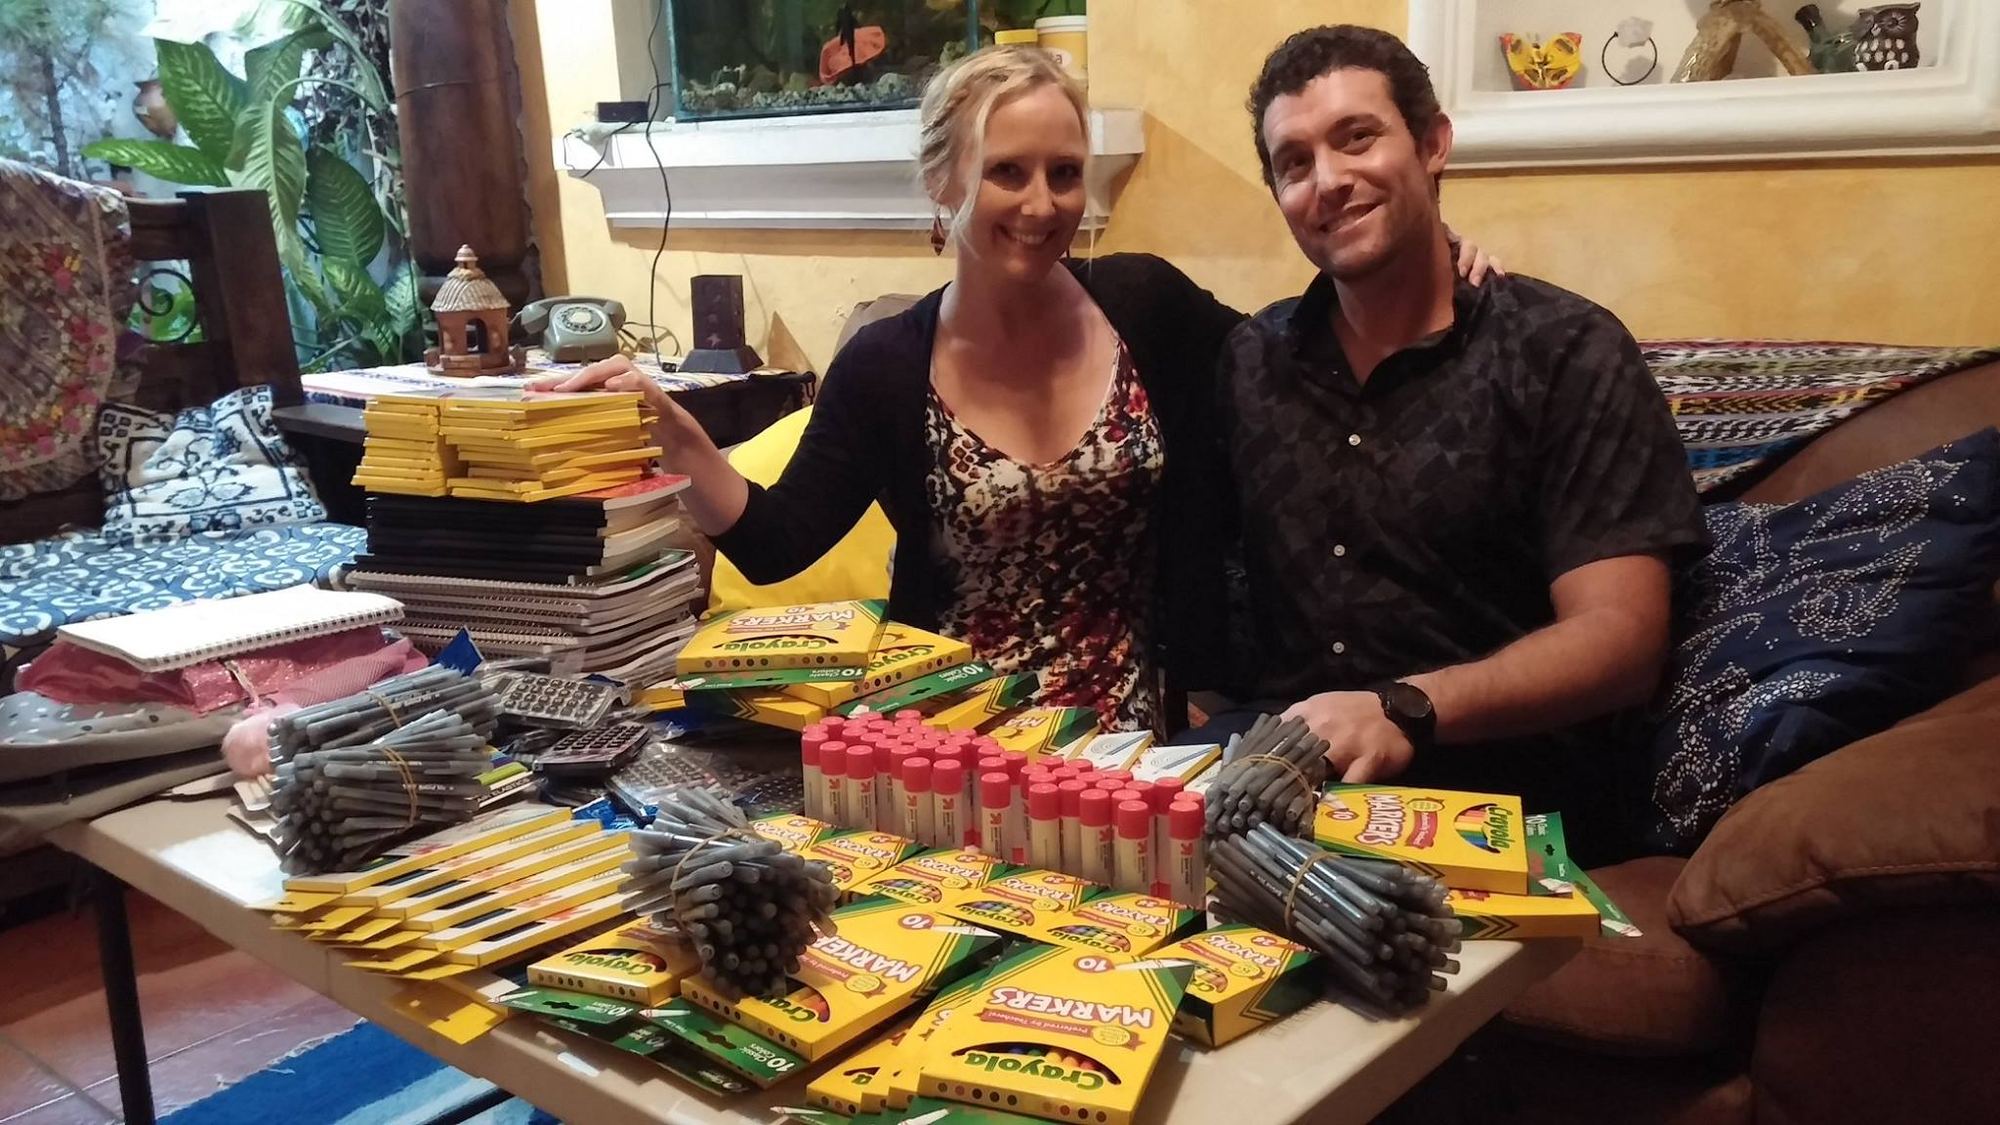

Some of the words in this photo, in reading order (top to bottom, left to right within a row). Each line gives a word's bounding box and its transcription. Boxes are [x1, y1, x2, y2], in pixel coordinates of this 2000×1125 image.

[732, 609, 855, 626] MARKERS
[724, 639, 828, 652] Crayola
[867, 646, 933, 672] Crayo
[841, 667, 864, 677] 10
[962, 663, 985, 676] 10
[1355, 793, 1405, 845] MARKERS
[1482, 807, 1516, 849] Crayola
[1525, 814, 1547, 824] 10
[834, 838, 897, 859] CRAYONS
[918, 858, 984, 880] CRAYONS
[872, 884, 931, 904] Crayola
[1003, 878, 1075, 901] CRAYONS
[902, 914, 931, 928] 10
[960, 905, 1025, 928] Crayola
[1096, 901, 1171, 926] CRAYONS
[809, 921, 922, 983] MARKER
[1051, 931, 1121, 954] Crayola
[1208, 934, 1281, 968] CRAYONS
[565, 953, 653, 975] Crayola
[1077, 957, 1108, 972] 10
[607, 1006, 634, 1017] 10
[991, 987, 1154, 1029] MARKERS
[985, 1011, 1028, 1026] Teachers!
[1043, 1020, 1089, 1035] Preferred
[739, 1046, 767, 1062] Classic
[749, 1042, 776, 1058] Colors
[767, 1057, 795, 1072] 10
[964, 1052, 1104, 1091] Crayola
